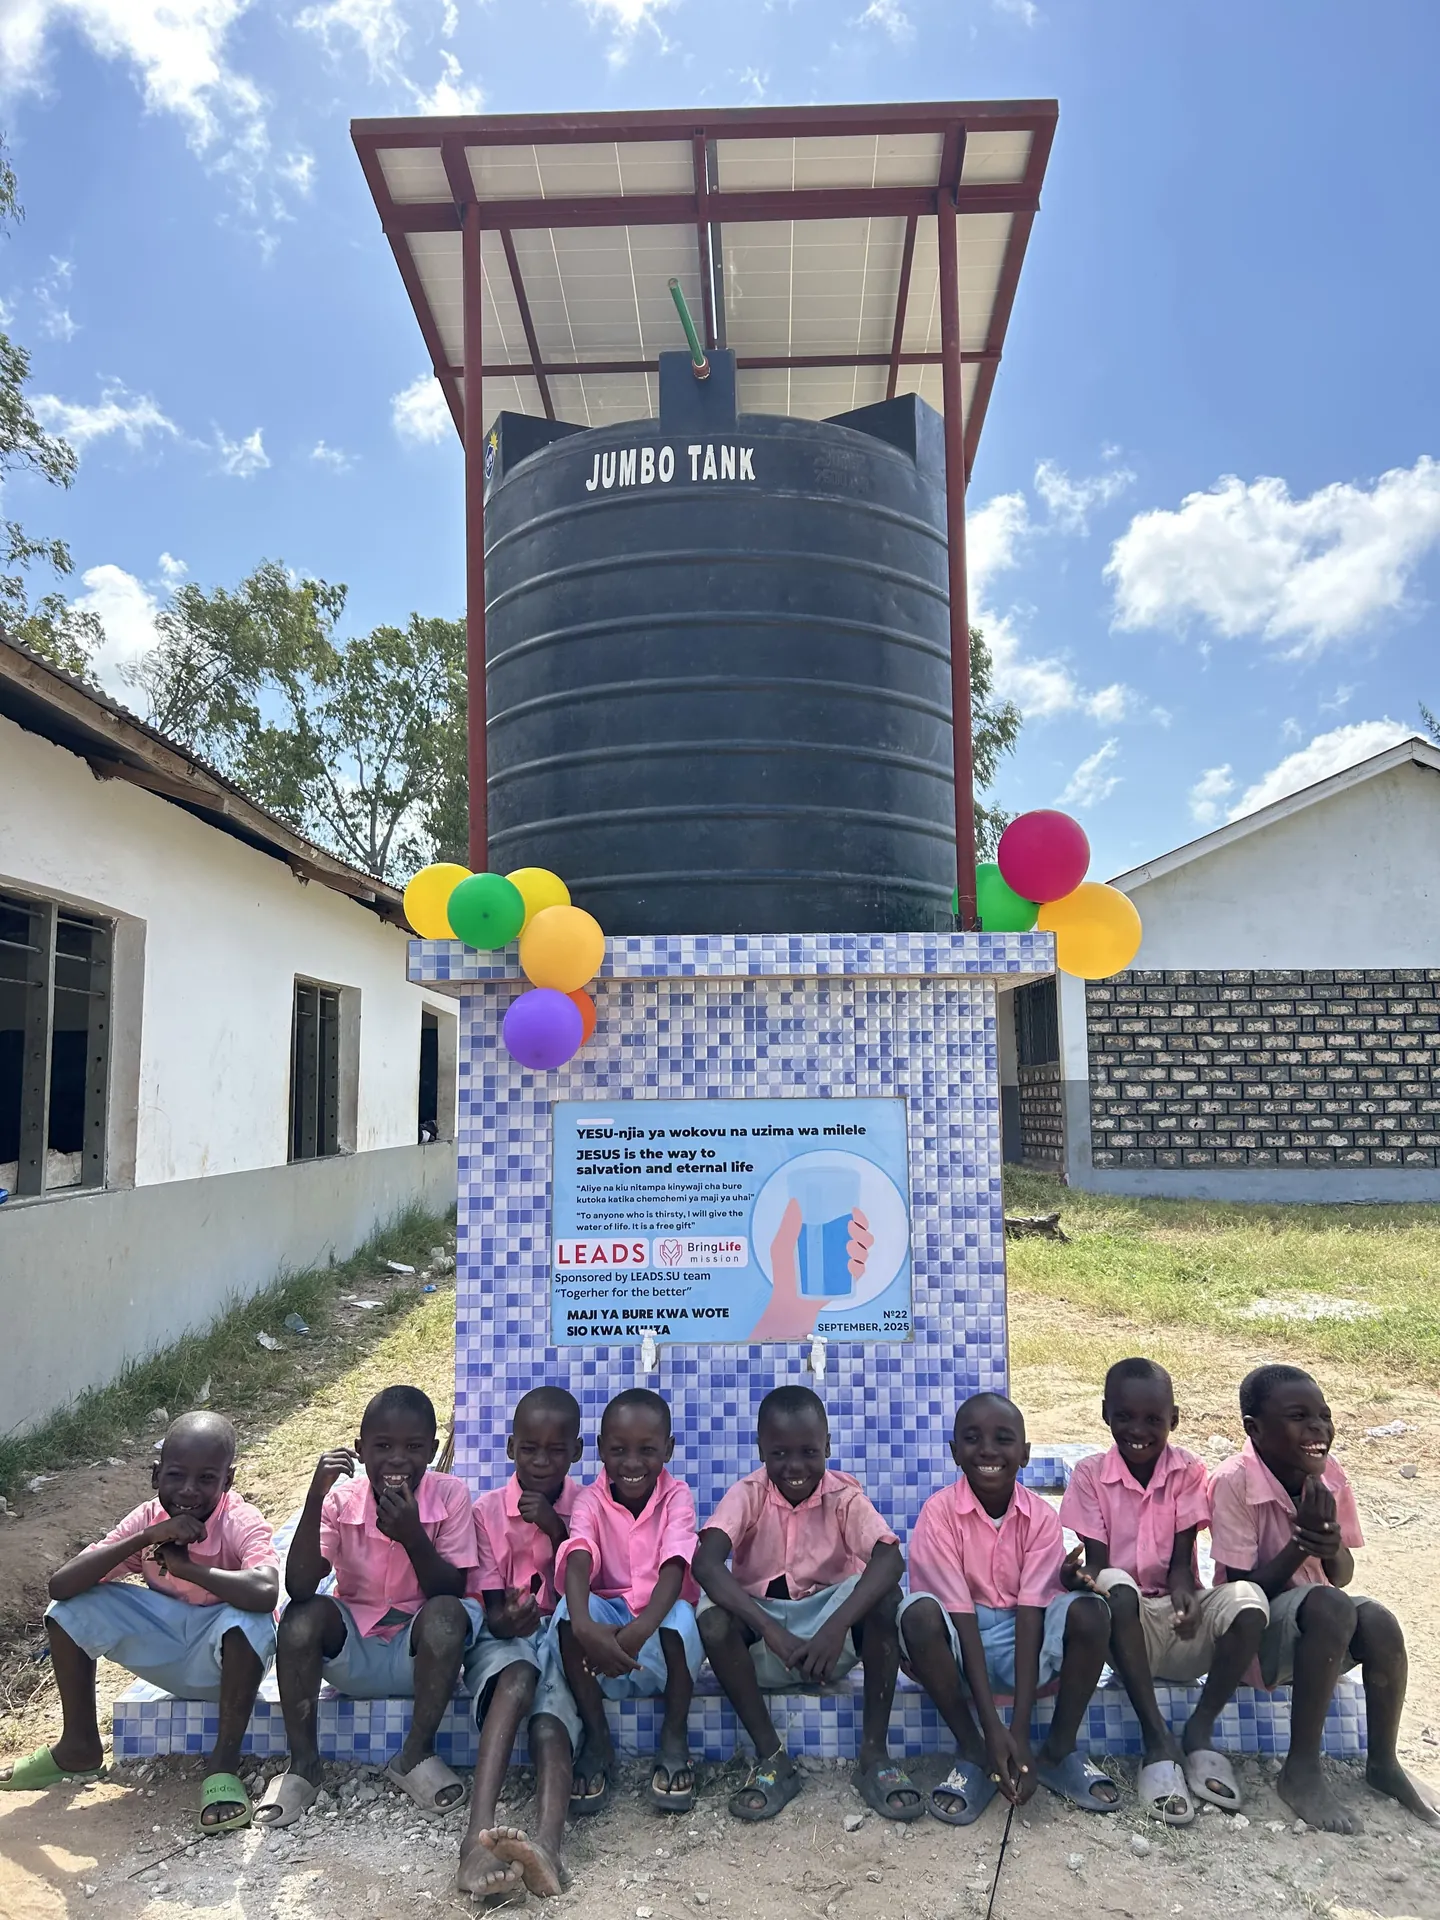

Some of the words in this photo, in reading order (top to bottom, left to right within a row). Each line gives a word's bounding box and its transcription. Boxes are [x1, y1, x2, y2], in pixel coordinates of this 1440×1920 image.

[586, 446, 674, 491] JUMBO
[688, 445, 755, 481] TANK
[577, 1127, 644, 1140] YESU-njia
[649, 1130, 665, 1140] ya
[670, 1127, 726, 1137] wokovu
[730, 1128, 747, 1136] na
[752, 1125, 794, 1136] uzima
[798, 1127, 819, 1135] wa
[823, 1124, 866, 1135] milele
[577, 1149, 620, 1160] JESUS
[624, 1148, 636, 1159] is
[640, 1149, 663, 1158] the
[668, 1150, 697, 1160] way
[701, 1149, 715, 1158] to
[577, 1164, 641, 1174] salvation
[646, 1163, 672, 1173] and
[677, 1162, 727, 1173] eternal
[731, 1161, 753, 1172] life
[631, 1184, 666, 1192] nitampa
[668, 1183, 702, 1192] kinywaji
[655, 1211, 686, 1219] thirsty,
[709, 1210, 727, 1218] give
[688, 1242, 741, 1253] BringLife
[559, 1243, 645, 1264] LEADS
[555, 1273, 612, 1282] Sponsored
[615, 1272, 627, 1283] by
[631, 1272, 680, 1281] LEADS.SU
[684, 1272, 710, 1280] team
[612, 1288, 628, 1296] for
[631, 1288, 649, 1296] the
[567, 1310, 597, 1320] MAJI
[601, 1310, 619, 1320] YA
[622, 1309, 653, 1319] BURE
[657, 1309, 688, 1318] KWA
[692, 1308, 729, 1318] WOTE
[567, 1326, 587, 1336] SIO
[591, 1326, 622, 1335] KWA
[818, 1323, 881, 1332] SEPTEMBER,
